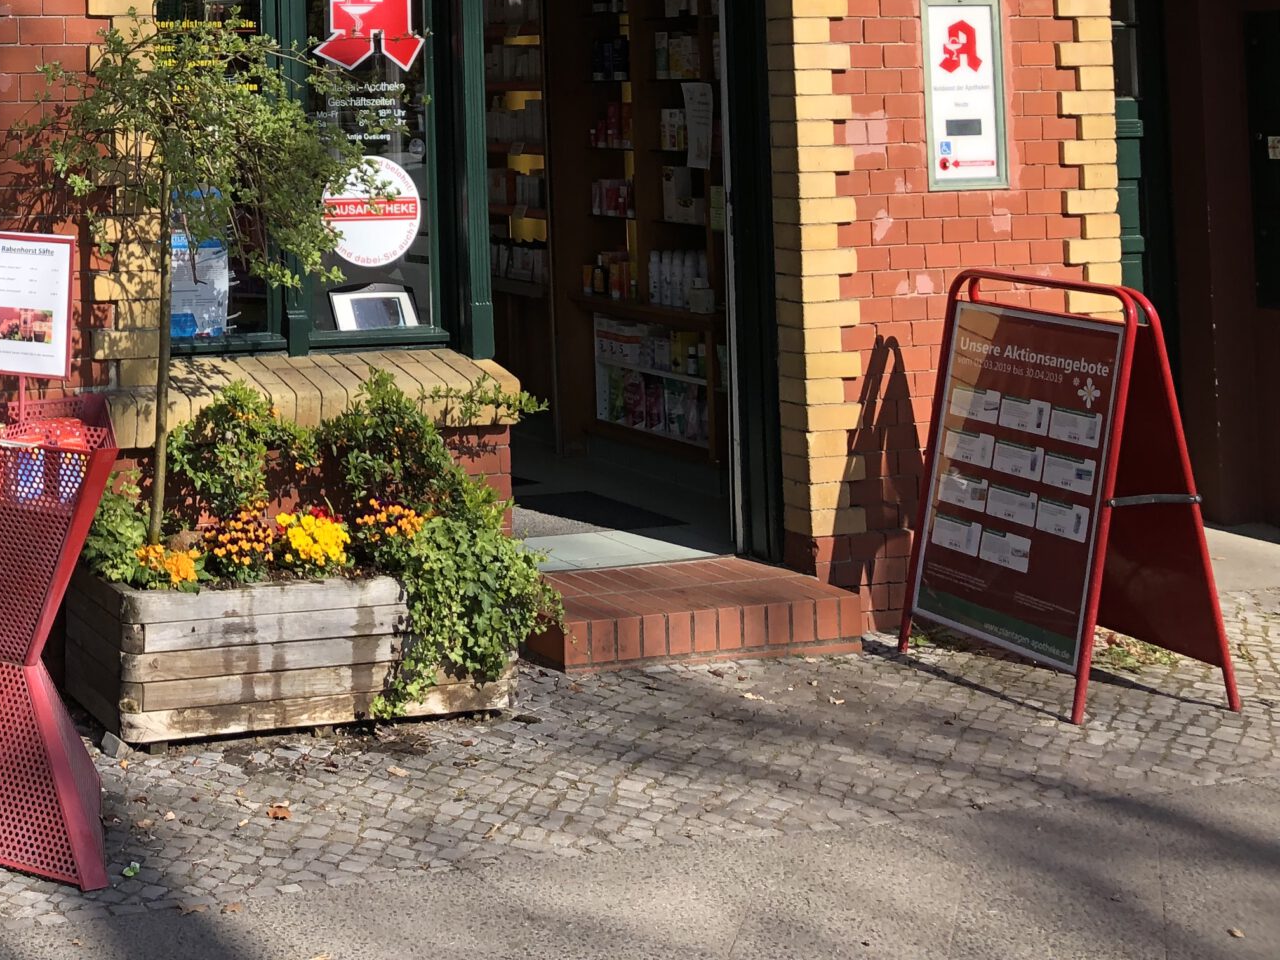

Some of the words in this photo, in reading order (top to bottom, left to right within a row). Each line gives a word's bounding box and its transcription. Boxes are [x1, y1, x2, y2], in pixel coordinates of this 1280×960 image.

[393, 109, 406, 117] Uhr
[1, 245, 37, 255] Rabenhorst
[38, 247, 55, 256] Säfte
[960, 336, 1001, 357] Unsere
[1004, 344, 1110, 378] Aktionsangebote
[1012, 365, 1024, 377] bis
